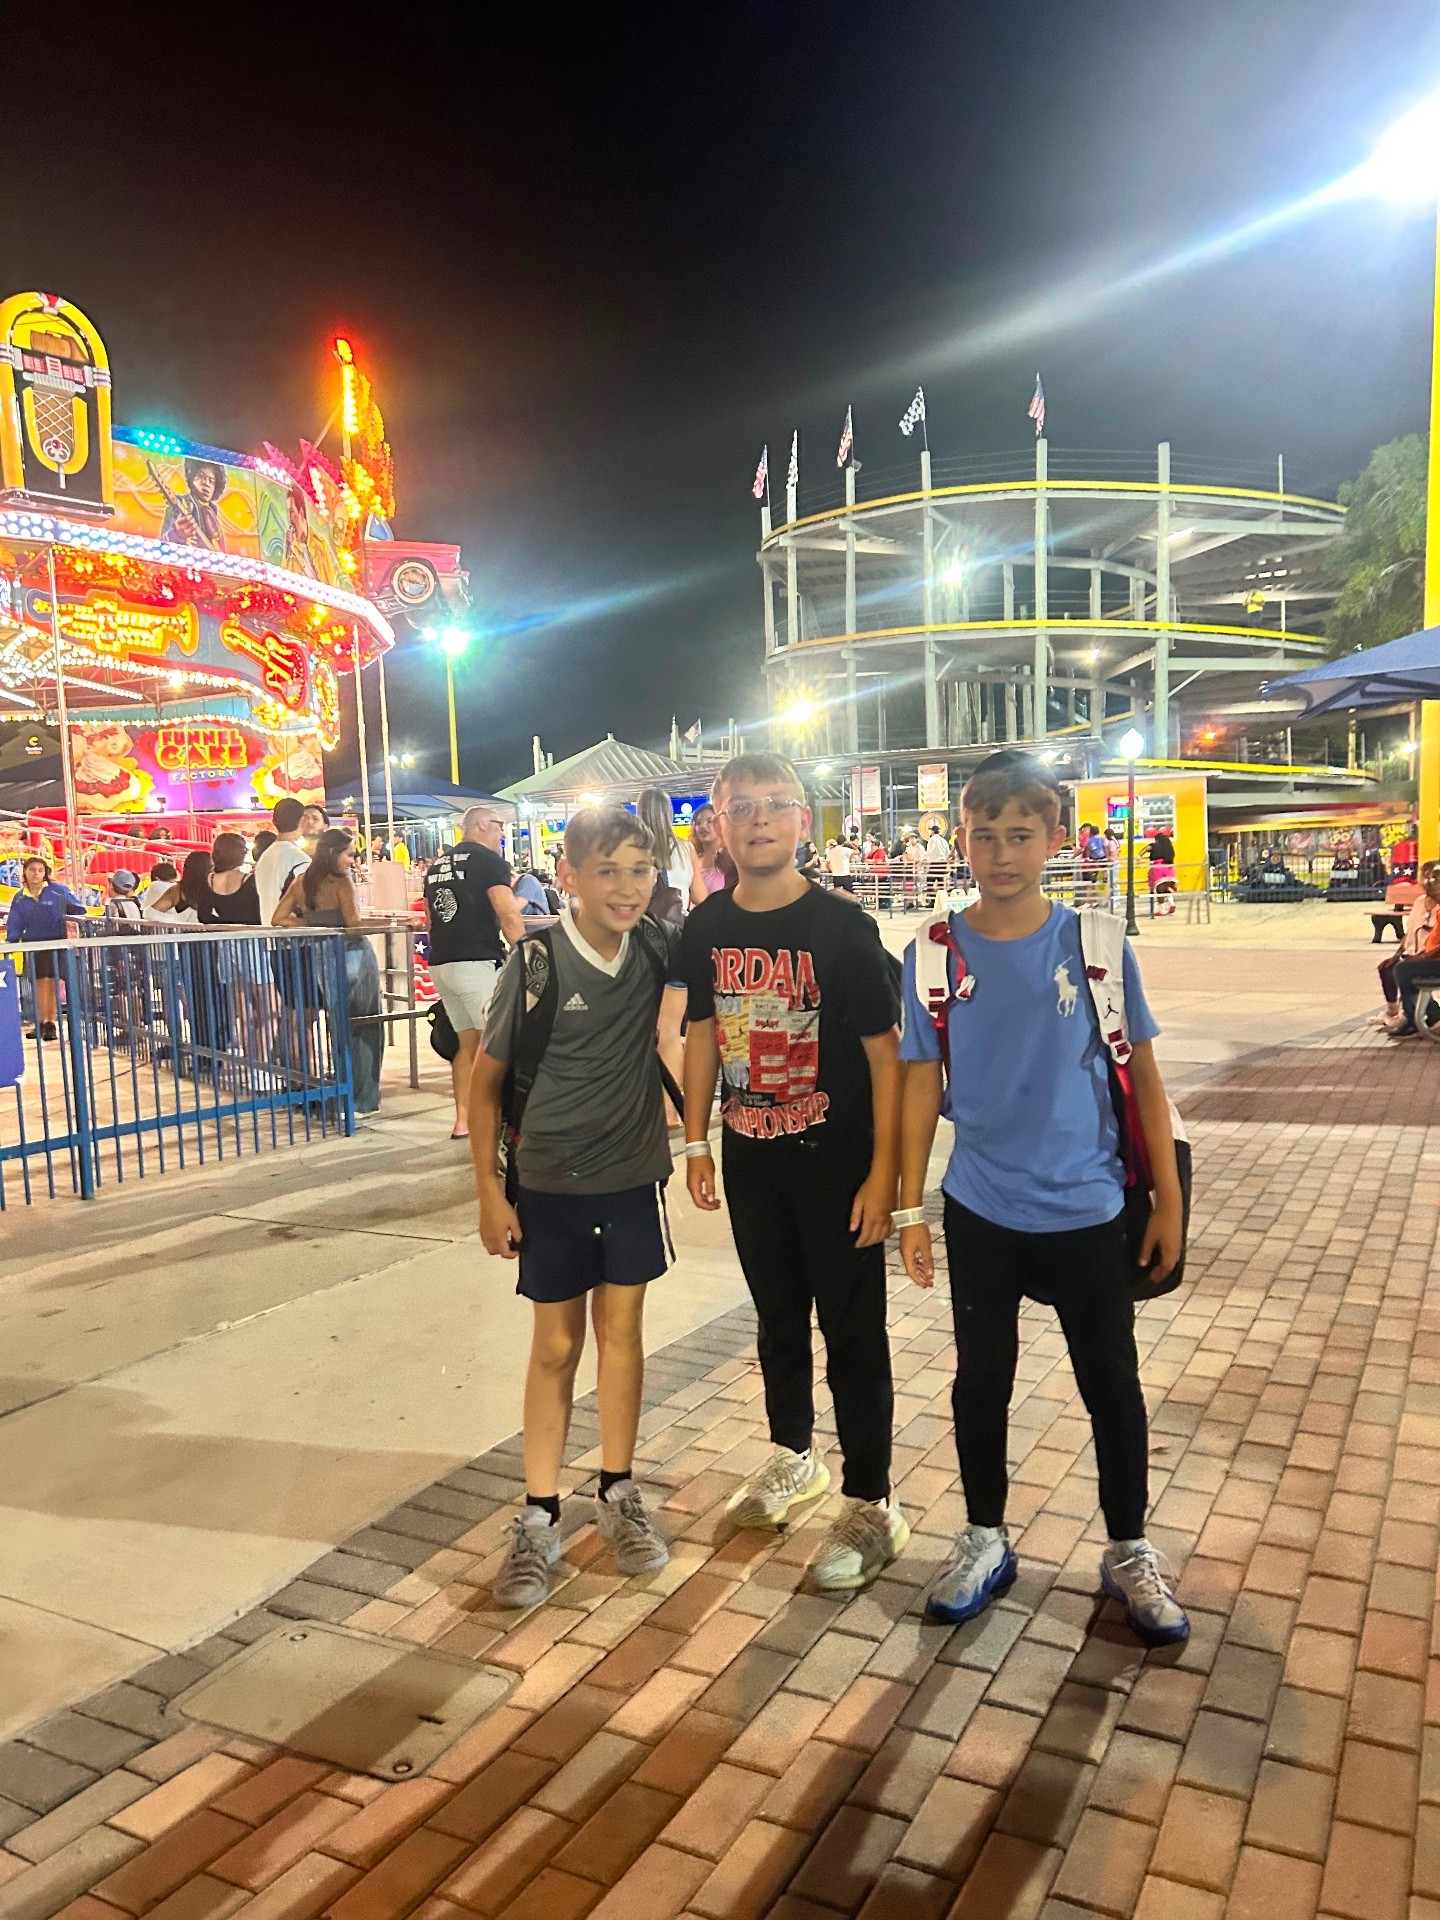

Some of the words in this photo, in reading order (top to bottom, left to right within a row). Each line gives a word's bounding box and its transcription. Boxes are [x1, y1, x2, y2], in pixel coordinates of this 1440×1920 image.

[159, 729, 242, 746] FUNNEL
[160, 744, 245, 768] CAKE
[171, 769, 235, 781] FACTORY
